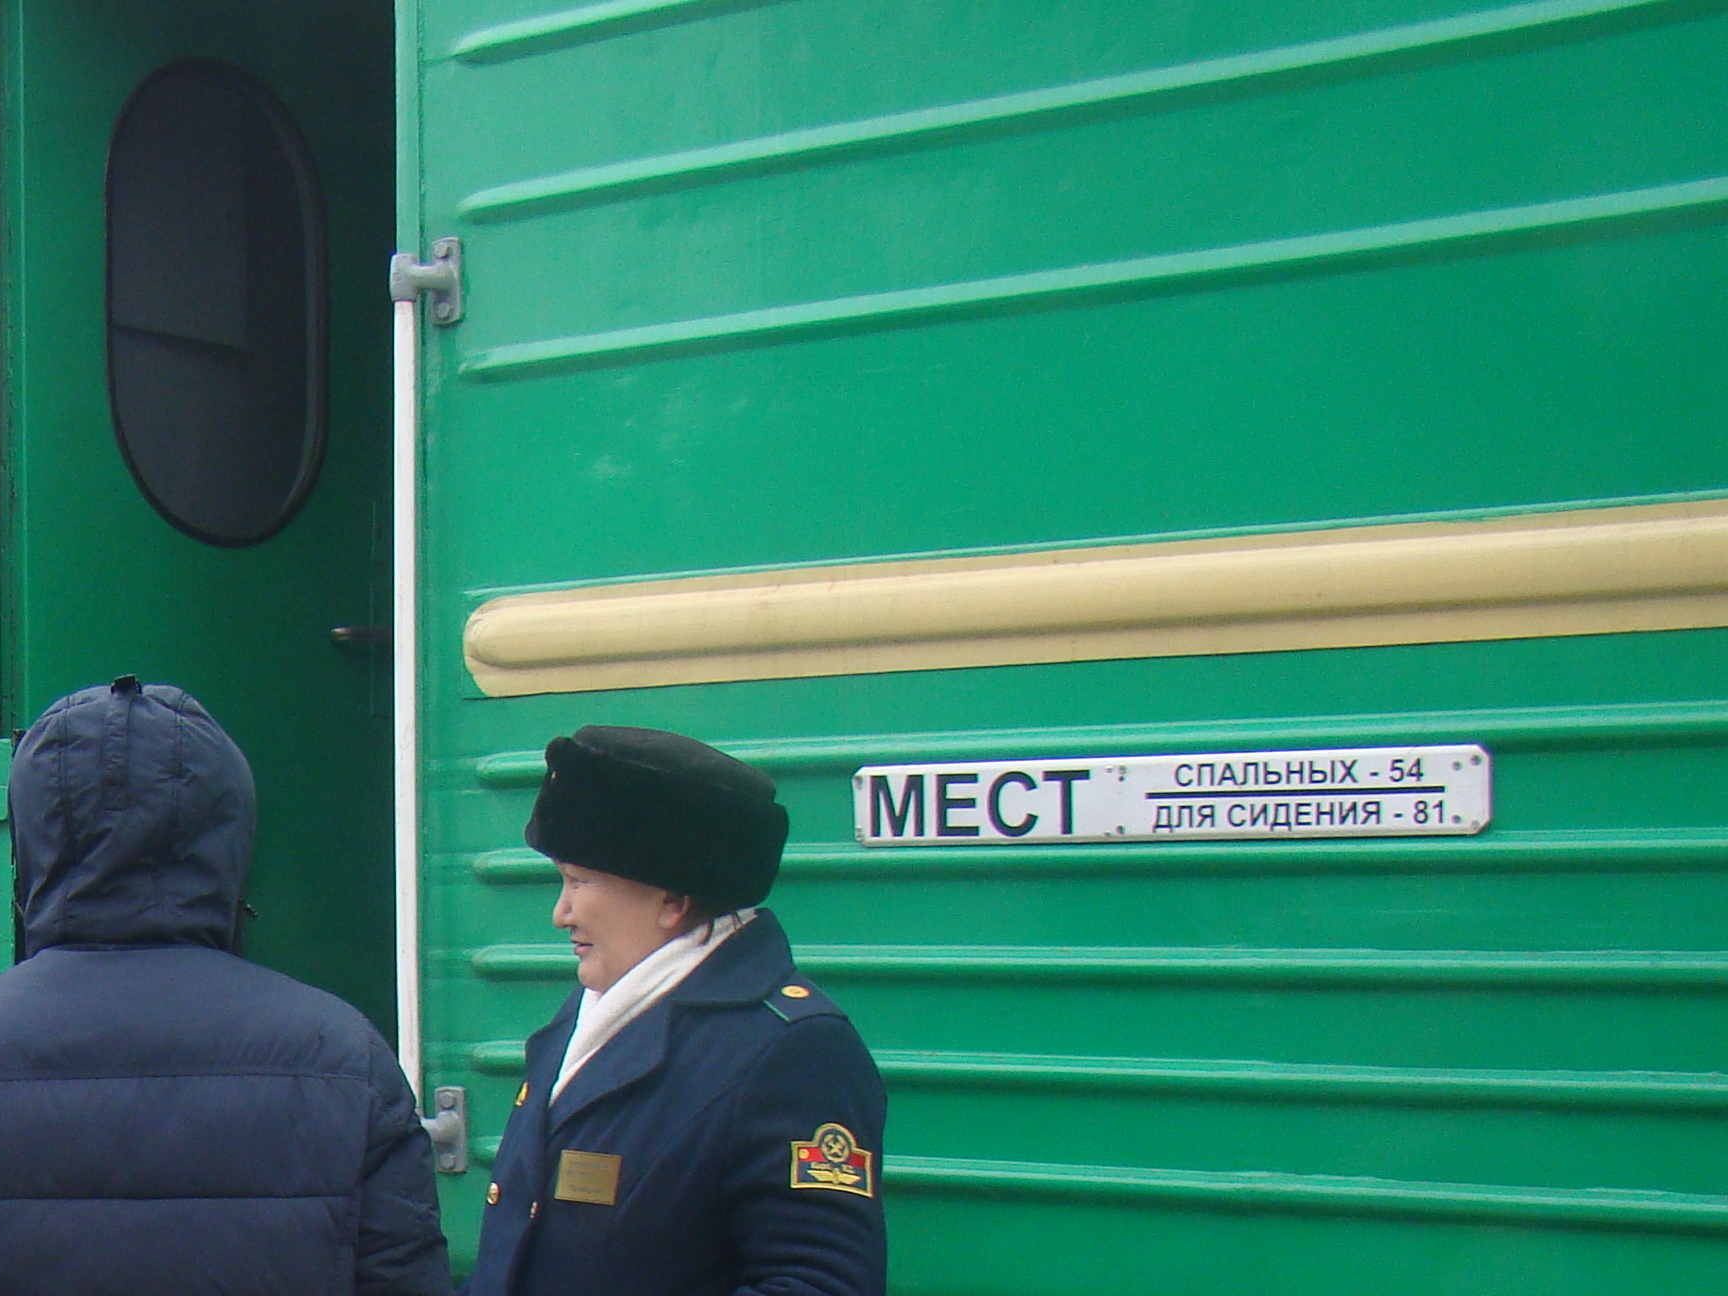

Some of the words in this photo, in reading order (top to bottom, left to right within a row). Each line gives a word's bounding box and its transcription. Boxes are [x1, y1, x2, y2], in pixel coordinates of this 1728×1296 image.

[1174, 759, 1358, 787] СПАЛЬНЫХ
[1389, 757, 1424, 783] 54
[869, 770, 1090, 838] МЕСТ
[1152, 803, 1215, 834] ДЛЯ
[1226, 801, 1381, 832] СИДЕНИЯ
[1412, 799, 1445, 825] 81
